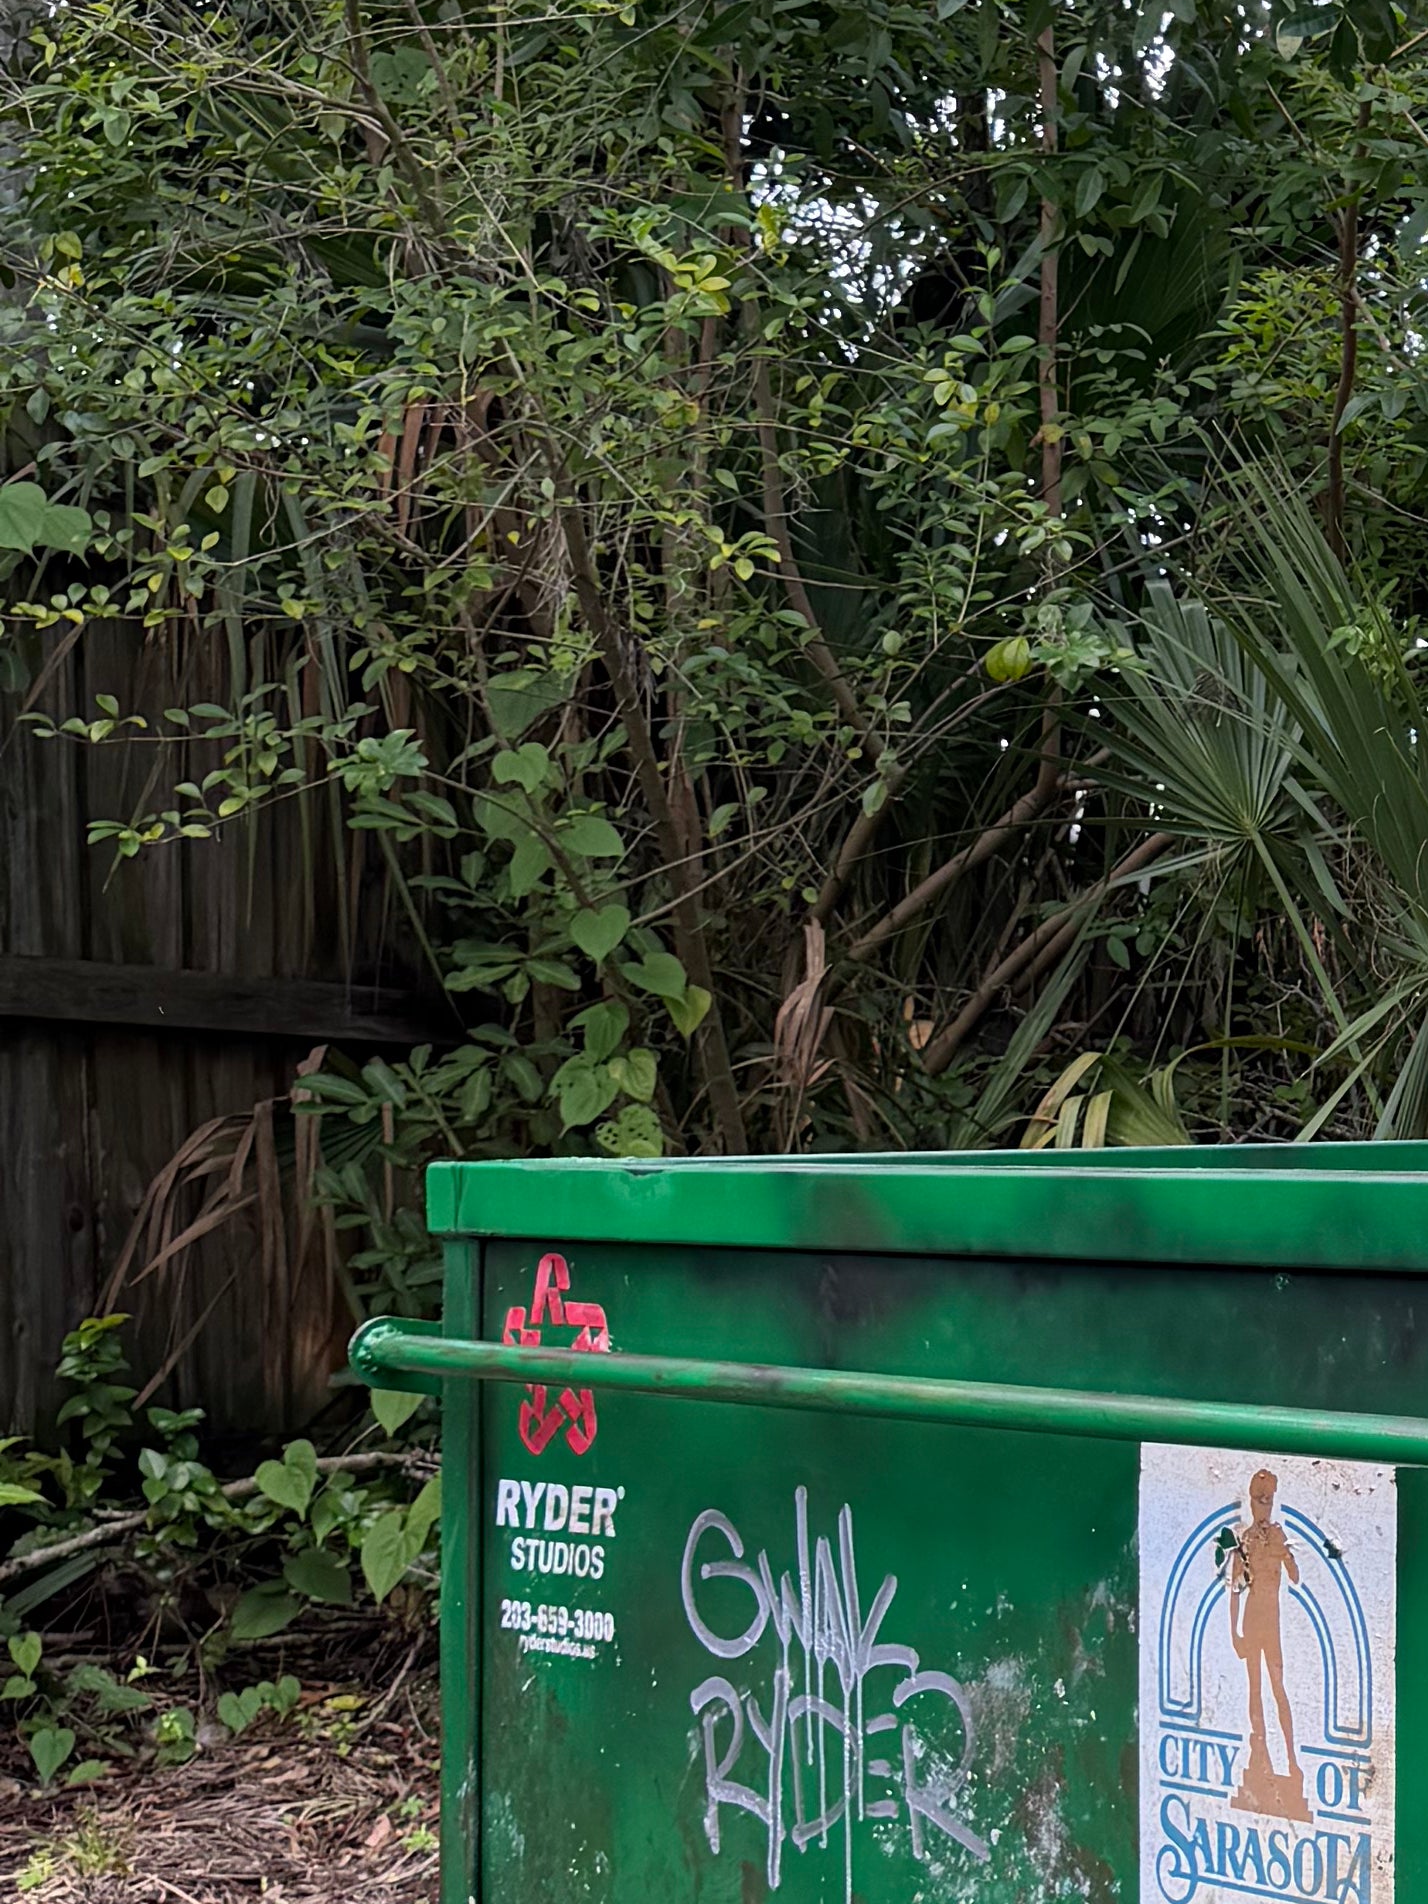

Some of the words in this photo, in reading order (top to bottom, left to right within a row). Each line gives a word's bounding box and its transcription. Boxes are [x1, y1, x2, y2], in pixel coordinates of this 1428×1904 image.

[496, 1479, 617, 1538] RYDER
[510, 1536, 605, 1580] STUDIOS
[501, 1598, 616, 1643] 203-659-3000
[1159, 1734, 1241, 1787] CITY
[1316, 1761, 1377, 1812] OF
